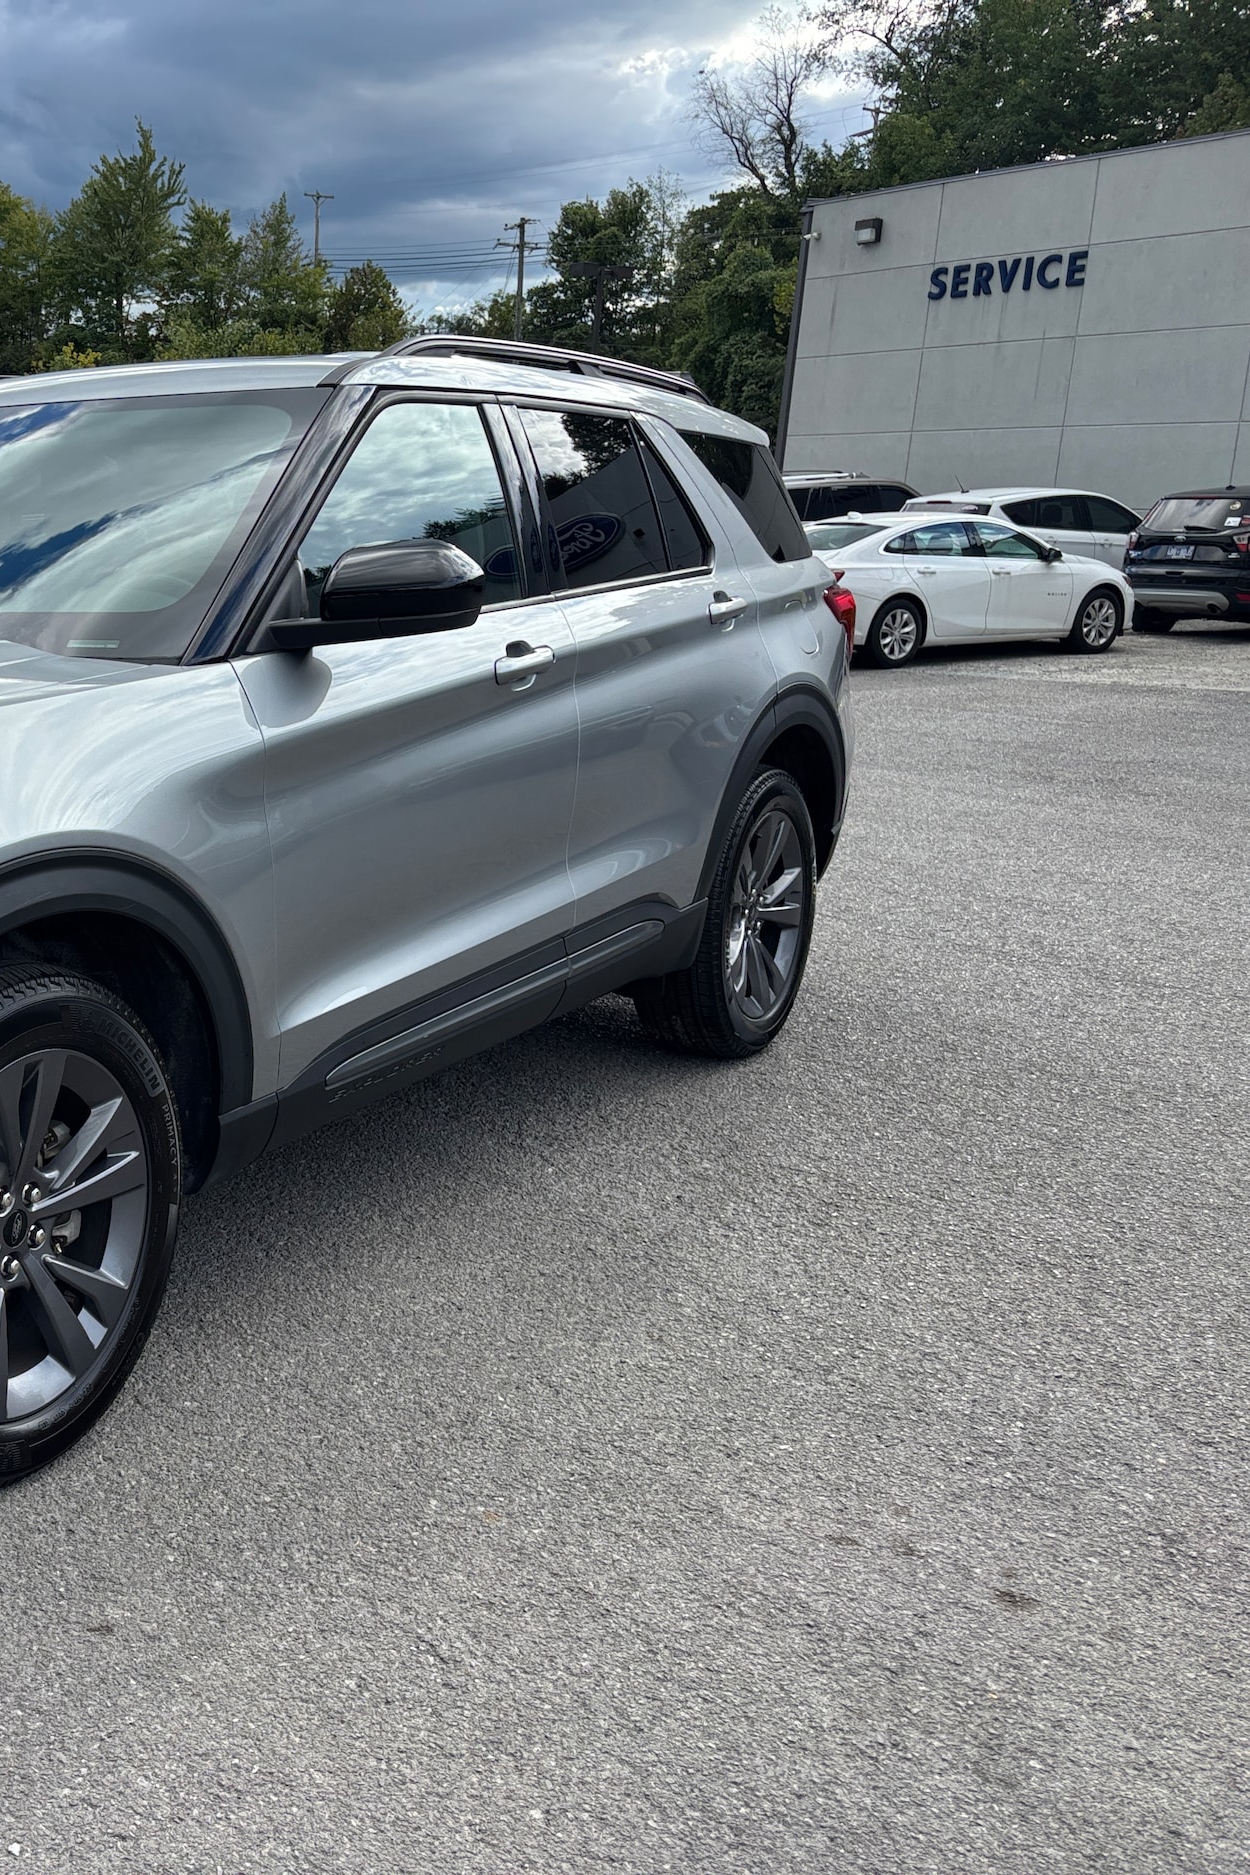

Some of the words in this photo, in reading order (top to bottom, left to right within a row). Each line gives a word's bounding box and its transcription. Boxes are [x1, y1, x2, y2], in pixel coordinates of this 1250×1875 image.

[927, 250, 1089, 301] SERVICE
[100, 1017, 161, 1092] MICHELIN
[161, 1103, 178, 1166] PRIMACY
